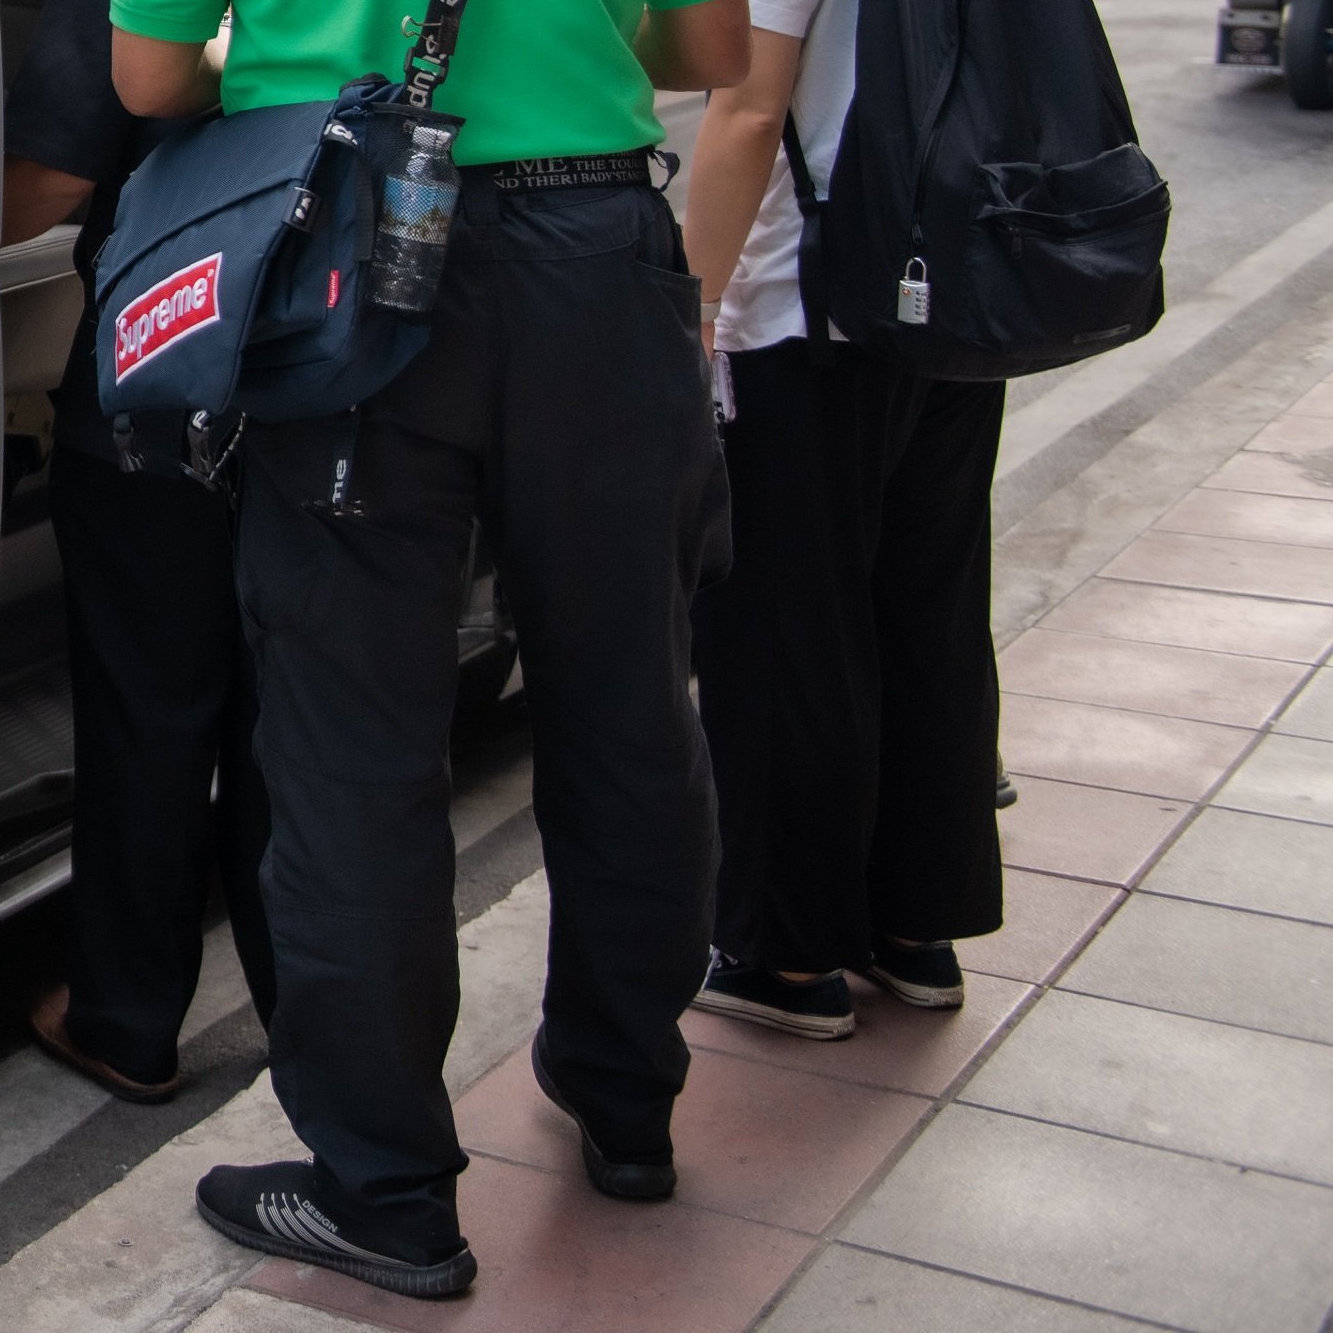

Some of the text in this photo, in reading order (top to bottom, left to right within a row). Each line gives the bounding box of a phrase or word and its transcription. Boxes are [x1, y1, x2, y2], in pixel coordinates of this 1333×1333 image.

[572, 160, 604, 171] THE
[118, 276, 208, 361] Supreme
[302, 1199, 339, 1233] DESIGN
